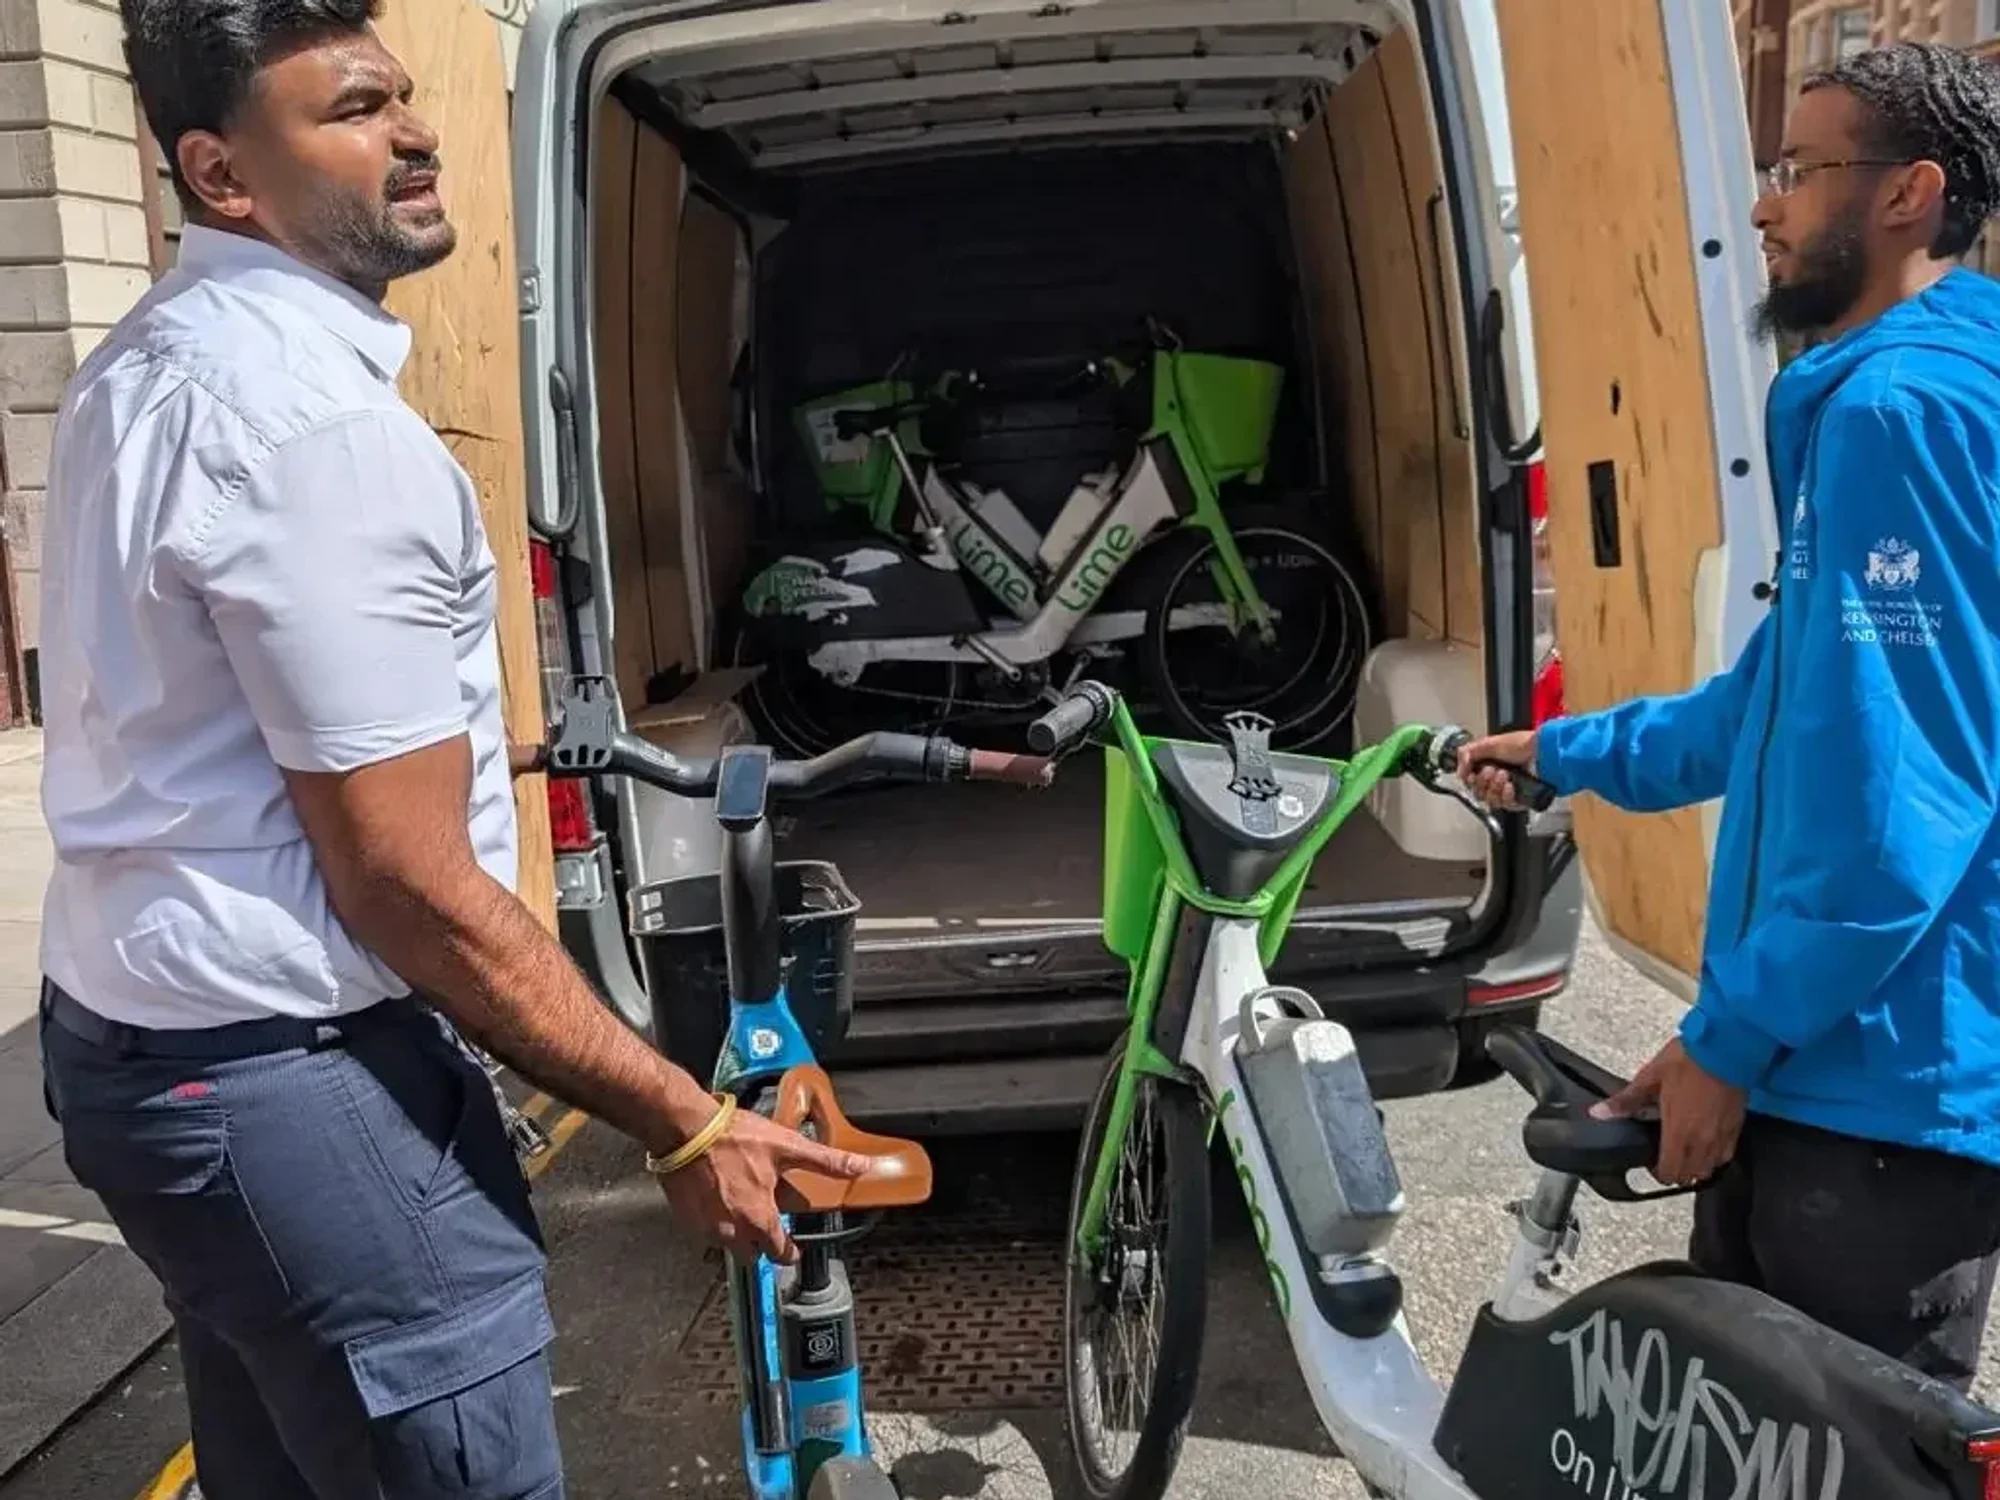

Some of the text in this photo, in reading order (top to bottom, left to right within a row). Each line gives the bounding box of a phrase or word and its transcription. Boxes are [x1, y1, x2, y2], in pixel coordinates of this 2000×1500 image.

[953, 523, 1030, 606] Lime
[1056, 523, 1135, 612] Lime
[1841, 629, 1877, 643] AND
[1551, 1428, 1596, 1496] On
